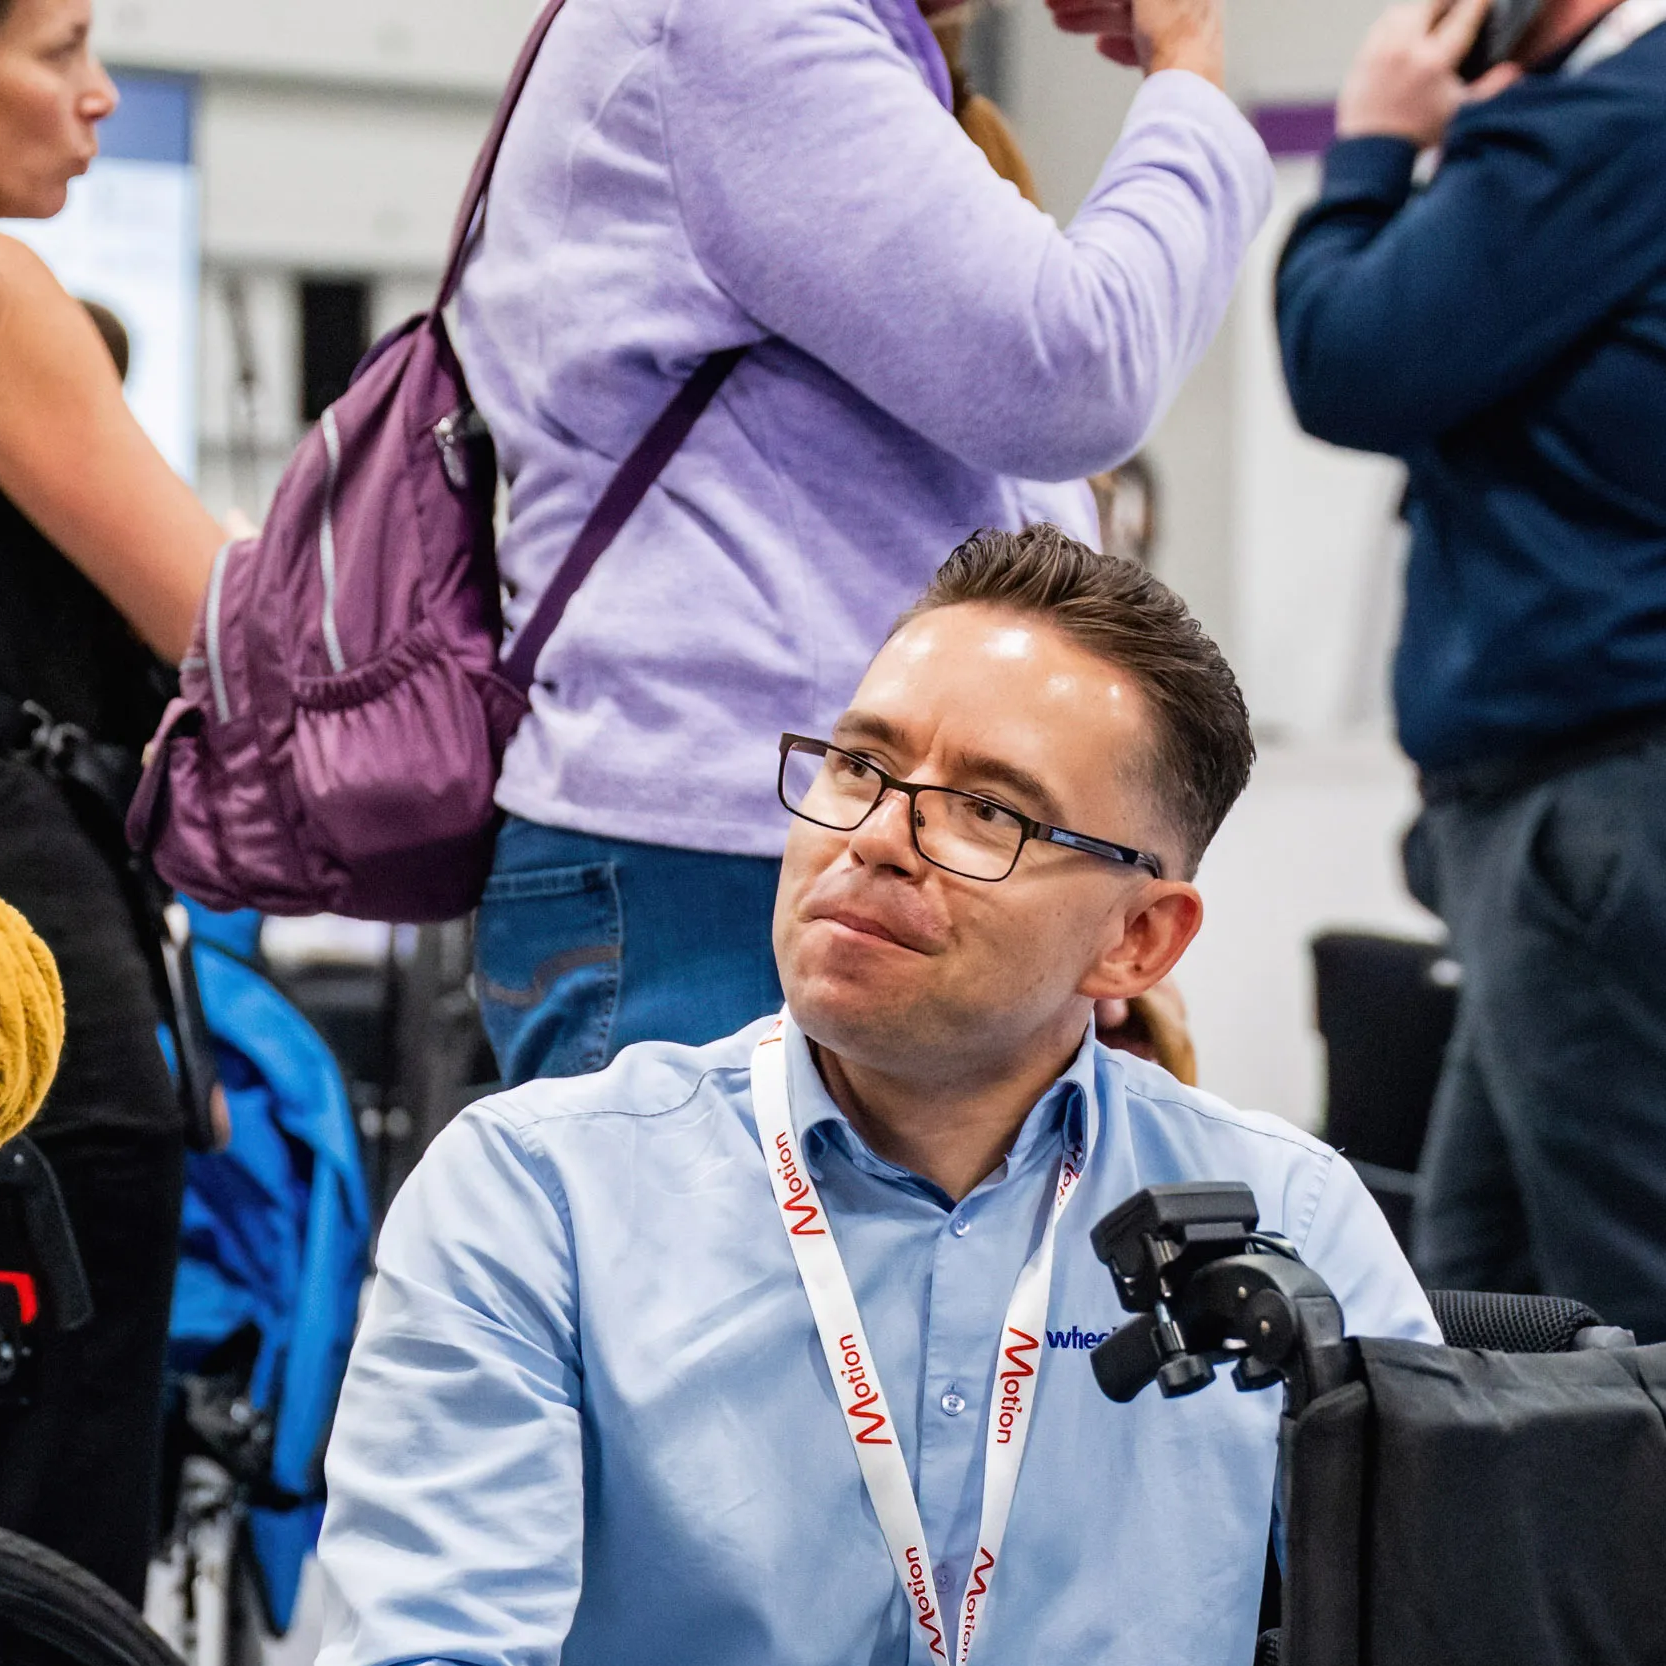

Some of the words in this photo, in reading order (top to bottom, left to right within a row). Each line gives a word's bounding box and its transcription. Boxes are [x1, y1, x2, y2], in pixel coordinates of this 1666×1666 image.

[776, 1132, 826, 1236] Motion
[839, 1333, 893, 1445] Motion
[997, 1326, 1041, 1444] Motion
